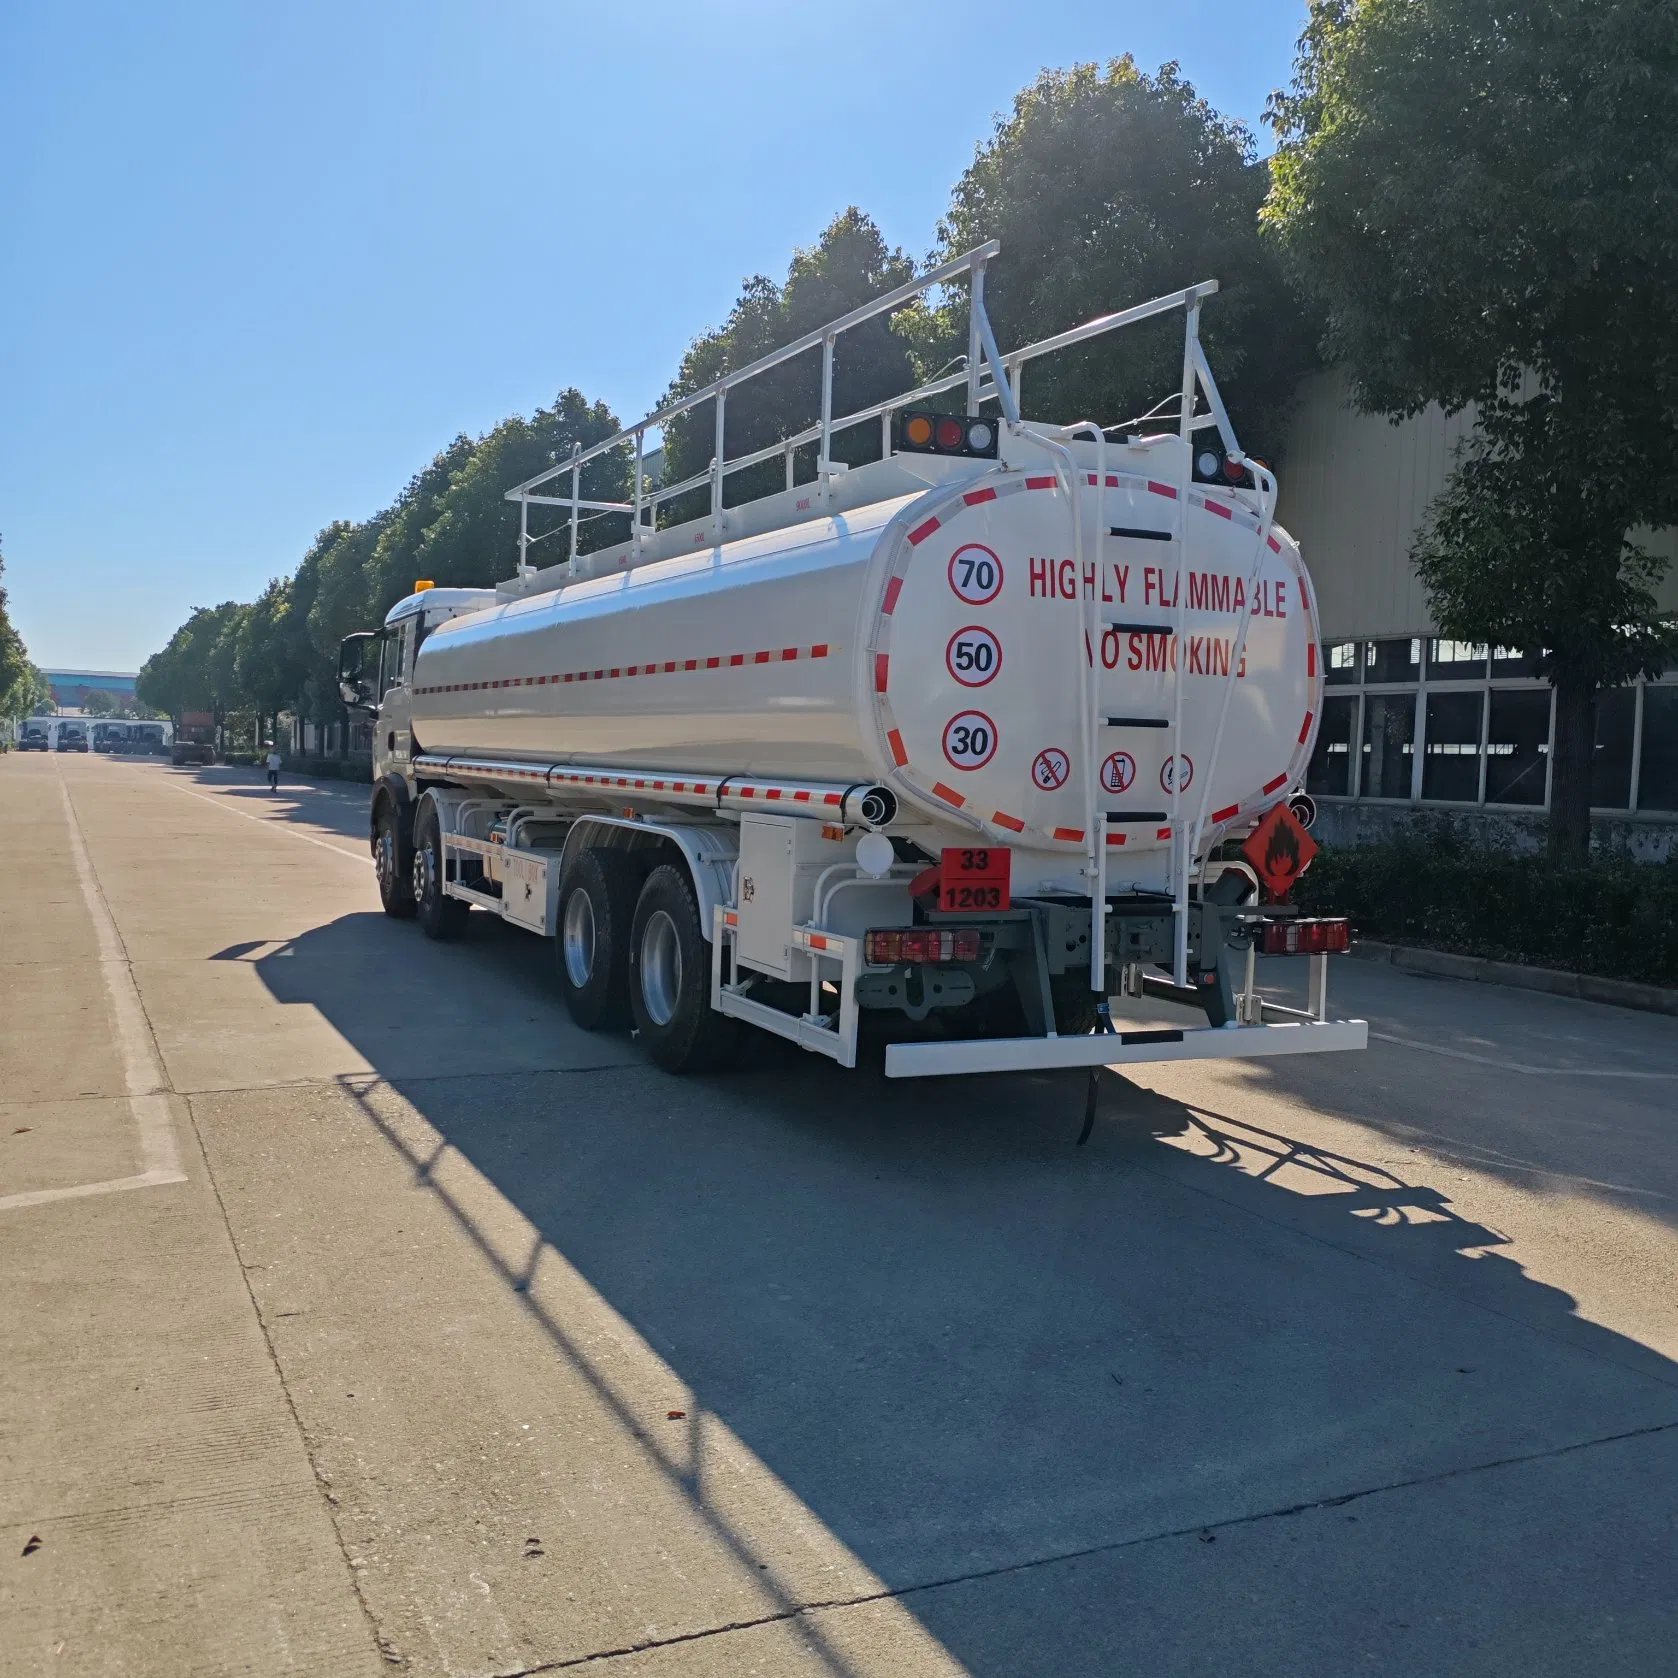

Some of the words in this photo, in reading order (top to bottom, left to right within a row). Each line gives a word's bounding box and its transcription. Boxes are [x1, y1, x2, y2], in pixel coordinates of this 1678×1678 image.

[957, 559, 995, 590] 70
[1029, 557, 1130, 604] HIGHLY
[955, 642, 993, 672] 50
[951, 726, 989, 756] 30
[961, 850, 989, 870] 33
[946, 887, 1001, 908] 1203
